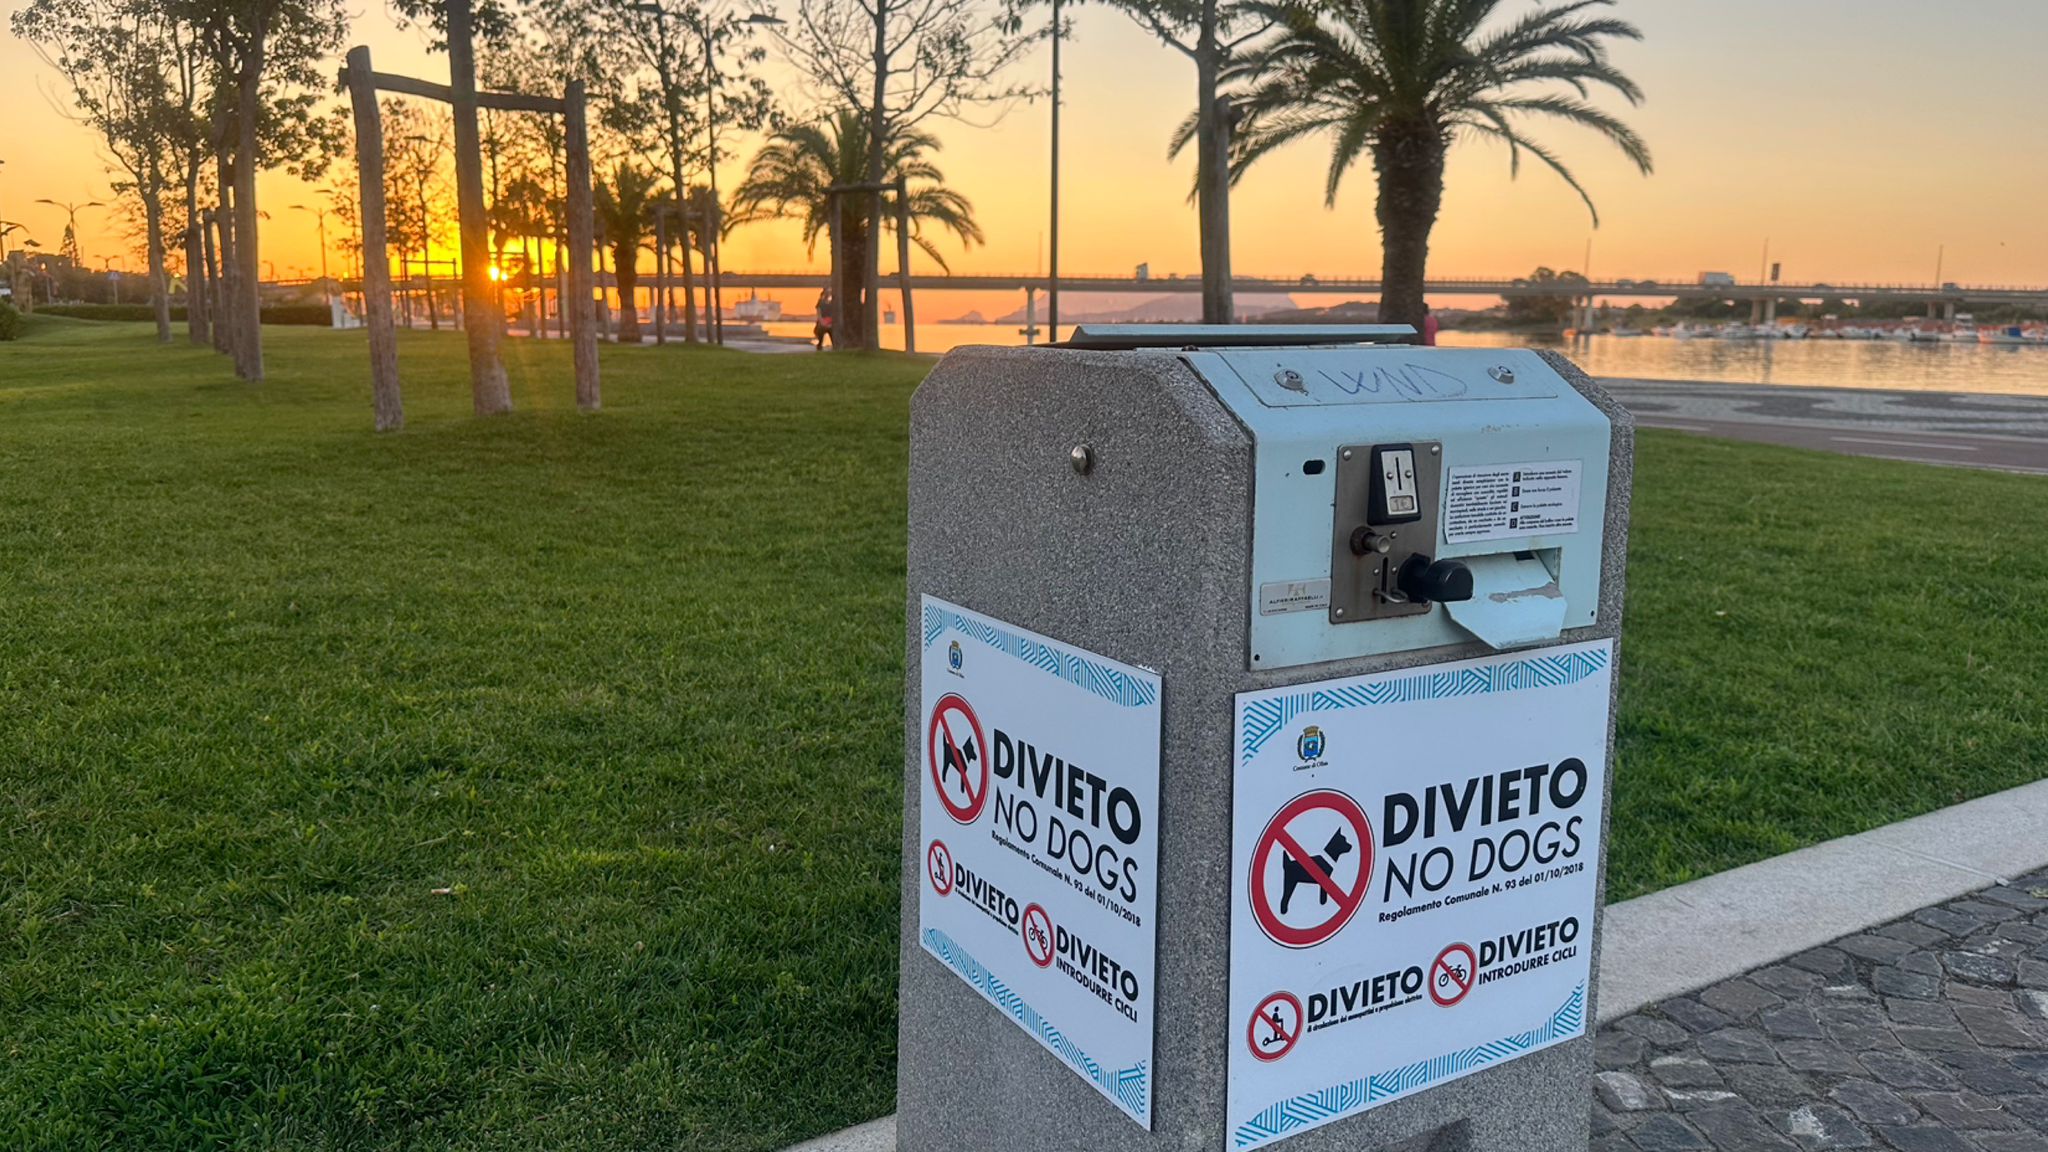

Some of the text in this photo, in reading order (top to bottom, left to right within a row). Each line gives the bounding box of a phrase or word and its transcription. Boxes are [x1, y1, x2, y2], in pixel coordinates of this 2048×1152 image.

[994, 728, 1141, 845] DIVIETO
[1383, 757, 1587, 848] DIVIETO
[991, 830, 1142, 928] Regolamento Comunale N. 93 del 01/10/2018
[994, 784, 1138, 903] NO DOGS
[1383, 815, 1583, 903] NO DOGS
[955, 862, 1019, 925] DIVIETO
[1378, 862, 1584, 923] Regolamento Comunale N. 93 del 01/10/2018
[1056, 924, 1139, 1001] DIVIETO
[1478, 945, 1577, 985] INTRODURRE CICLI
[1479, 916, 1579, 968] DIVIETO
[1056, 956, 1137, 1023] INTRODURRE CICLI
[1307, 965, 1424, 1024] DIVIETO
